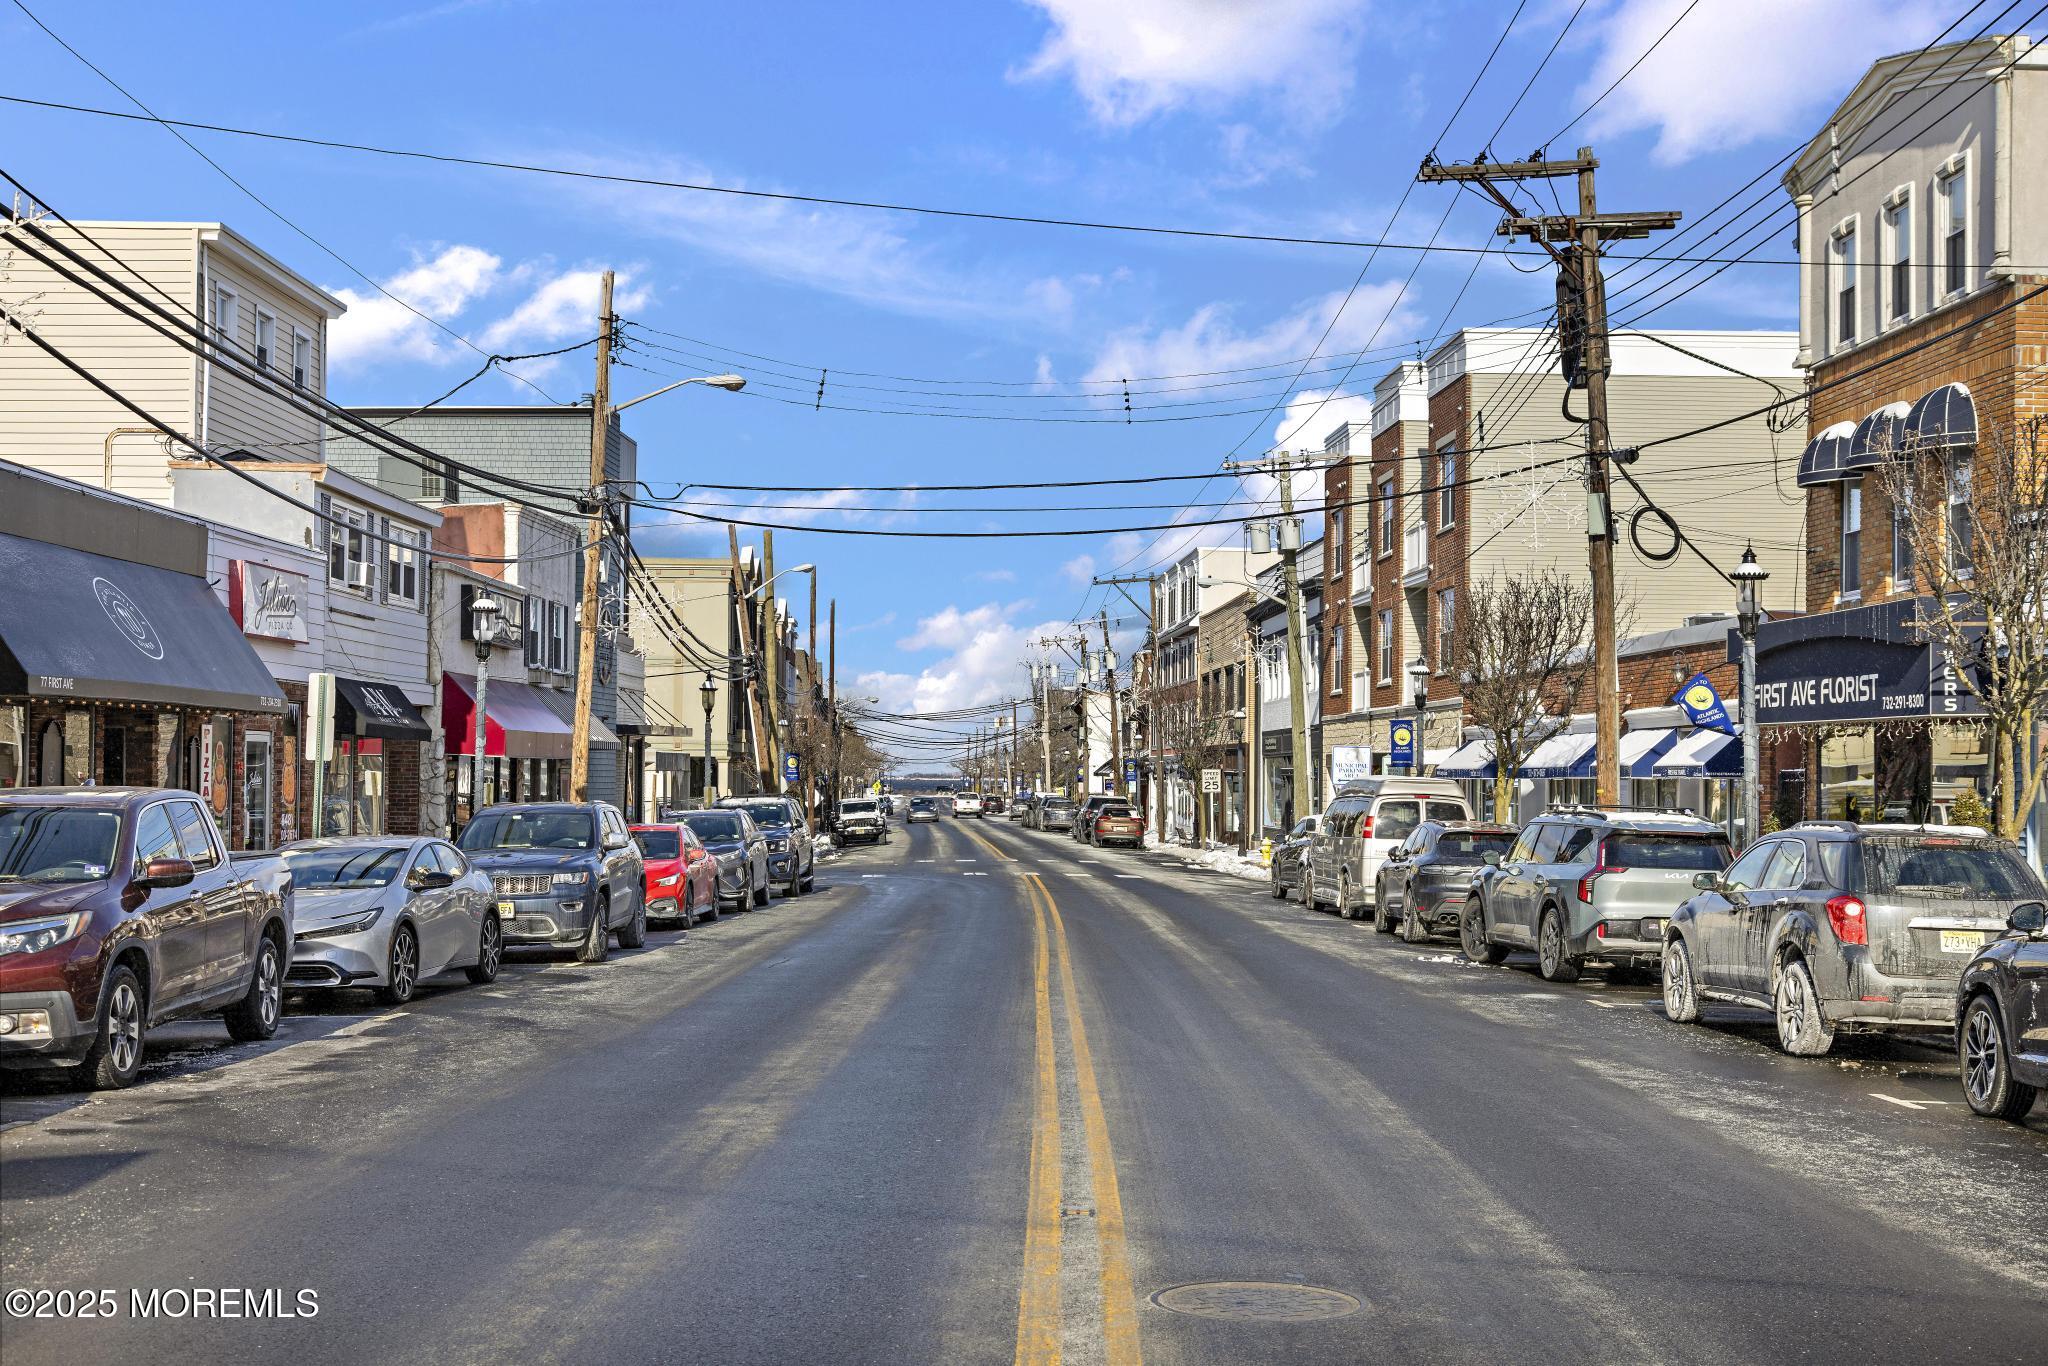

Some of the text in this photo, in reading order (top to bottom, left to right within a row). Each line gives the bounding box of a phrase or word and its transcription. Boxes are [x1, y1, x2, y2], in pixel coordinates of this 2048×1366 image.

[268, 621, 284, 631] PIZZA
[40, 675, 74, 690] 77 FIRST AVE
[1754, 673, 1879, 708] FIRST AVE FLORIST
[1882, 693, 1925, 710] 732-291-8300
[1695, 713, 1725, 725] HIGHLANDS
[1696, 708, 1719, 720] ATLANTIC
[203, 728, 211, 797] PIZZA
[1204, 781, 1219, 790] 25
